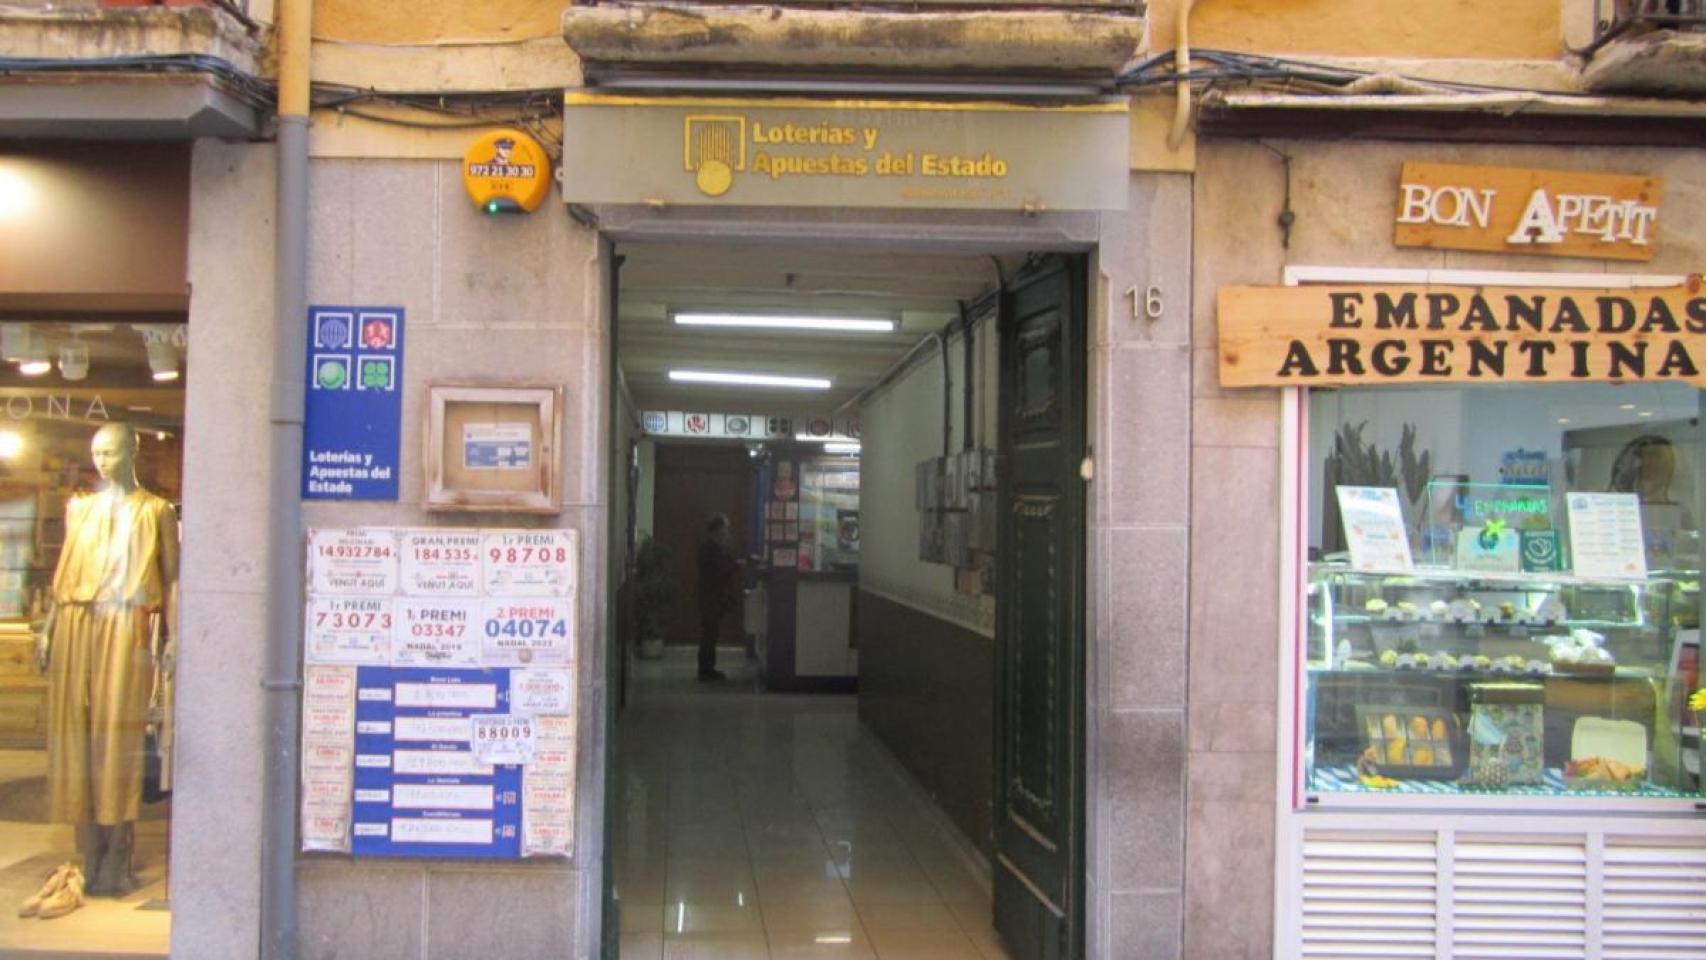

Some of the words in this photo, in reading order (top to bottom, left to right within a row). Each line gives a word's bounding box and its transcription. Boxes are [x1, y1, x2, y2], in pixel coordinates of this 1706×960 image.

[863, 128, 878, 150] y
[752, 152, 868, 179] Apuestas
[875, 153, 914, 176] del
[921, 153, 1008, 178] Estado
[1396, 183, 1497, 229] BON
[1507, 188, 1657, 246] APETIT
[1125, 284, 1165, 319] 16
[1328, 292, 1706, 334] EMPANADAS
[1276, 338, 1699, 378] ARGENTINA
[363, 454, 373, 467] y
[309, 466, 369, 482] Apuestas
[371, 466, 391, 479] del
[308, 481, 353, 494] Estado
[446, 536, 479, 546] PREMI
[517, 535, 555, 546] PREMI
[489, 547, 566, 563] 98708
[343, 600, 382, 611] PREMI
[509, 607, 555, 619] PREMI
[315, 612, 392, 628] 73073
[419, 609, 467, 621] PREMI
[411, 623, 466, 636] 03347
[484, 618, 567, 638] 04074
[478, 726, 531, 739] 88009
